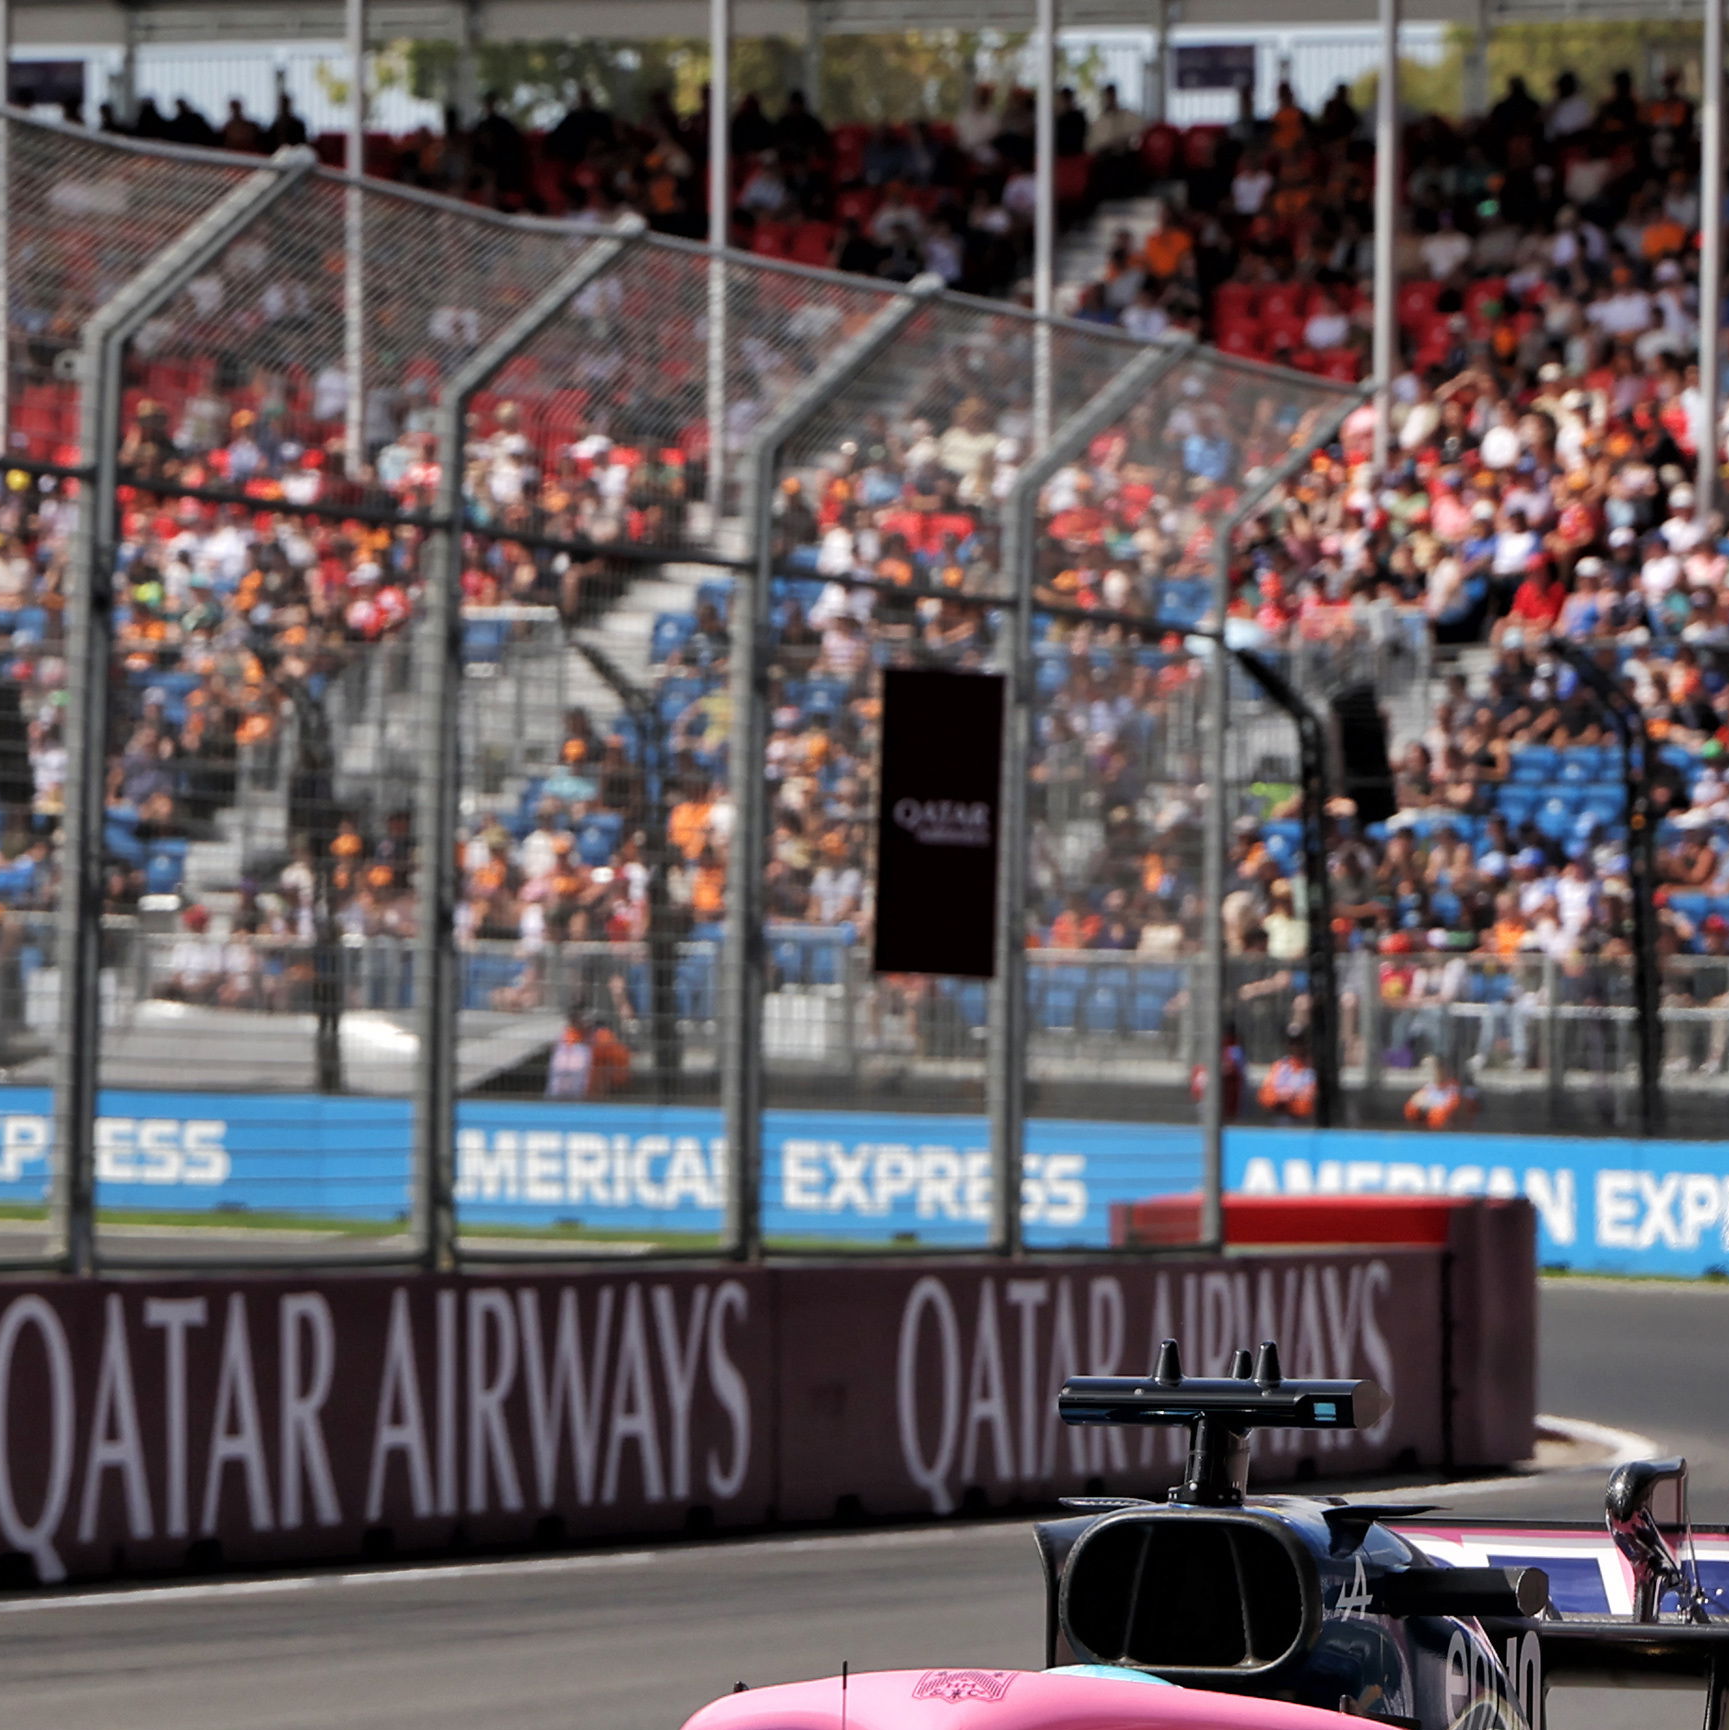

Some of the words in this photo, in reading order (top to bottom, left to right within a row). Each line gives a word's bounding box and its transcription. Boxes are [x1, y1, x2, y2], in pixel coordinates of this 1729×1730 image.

[454, 1127, 730, 1211] MERICA
[366, 1279, 752, 1523] AIRWAYS
[896, 1274, 1127, 1515] QATAR
